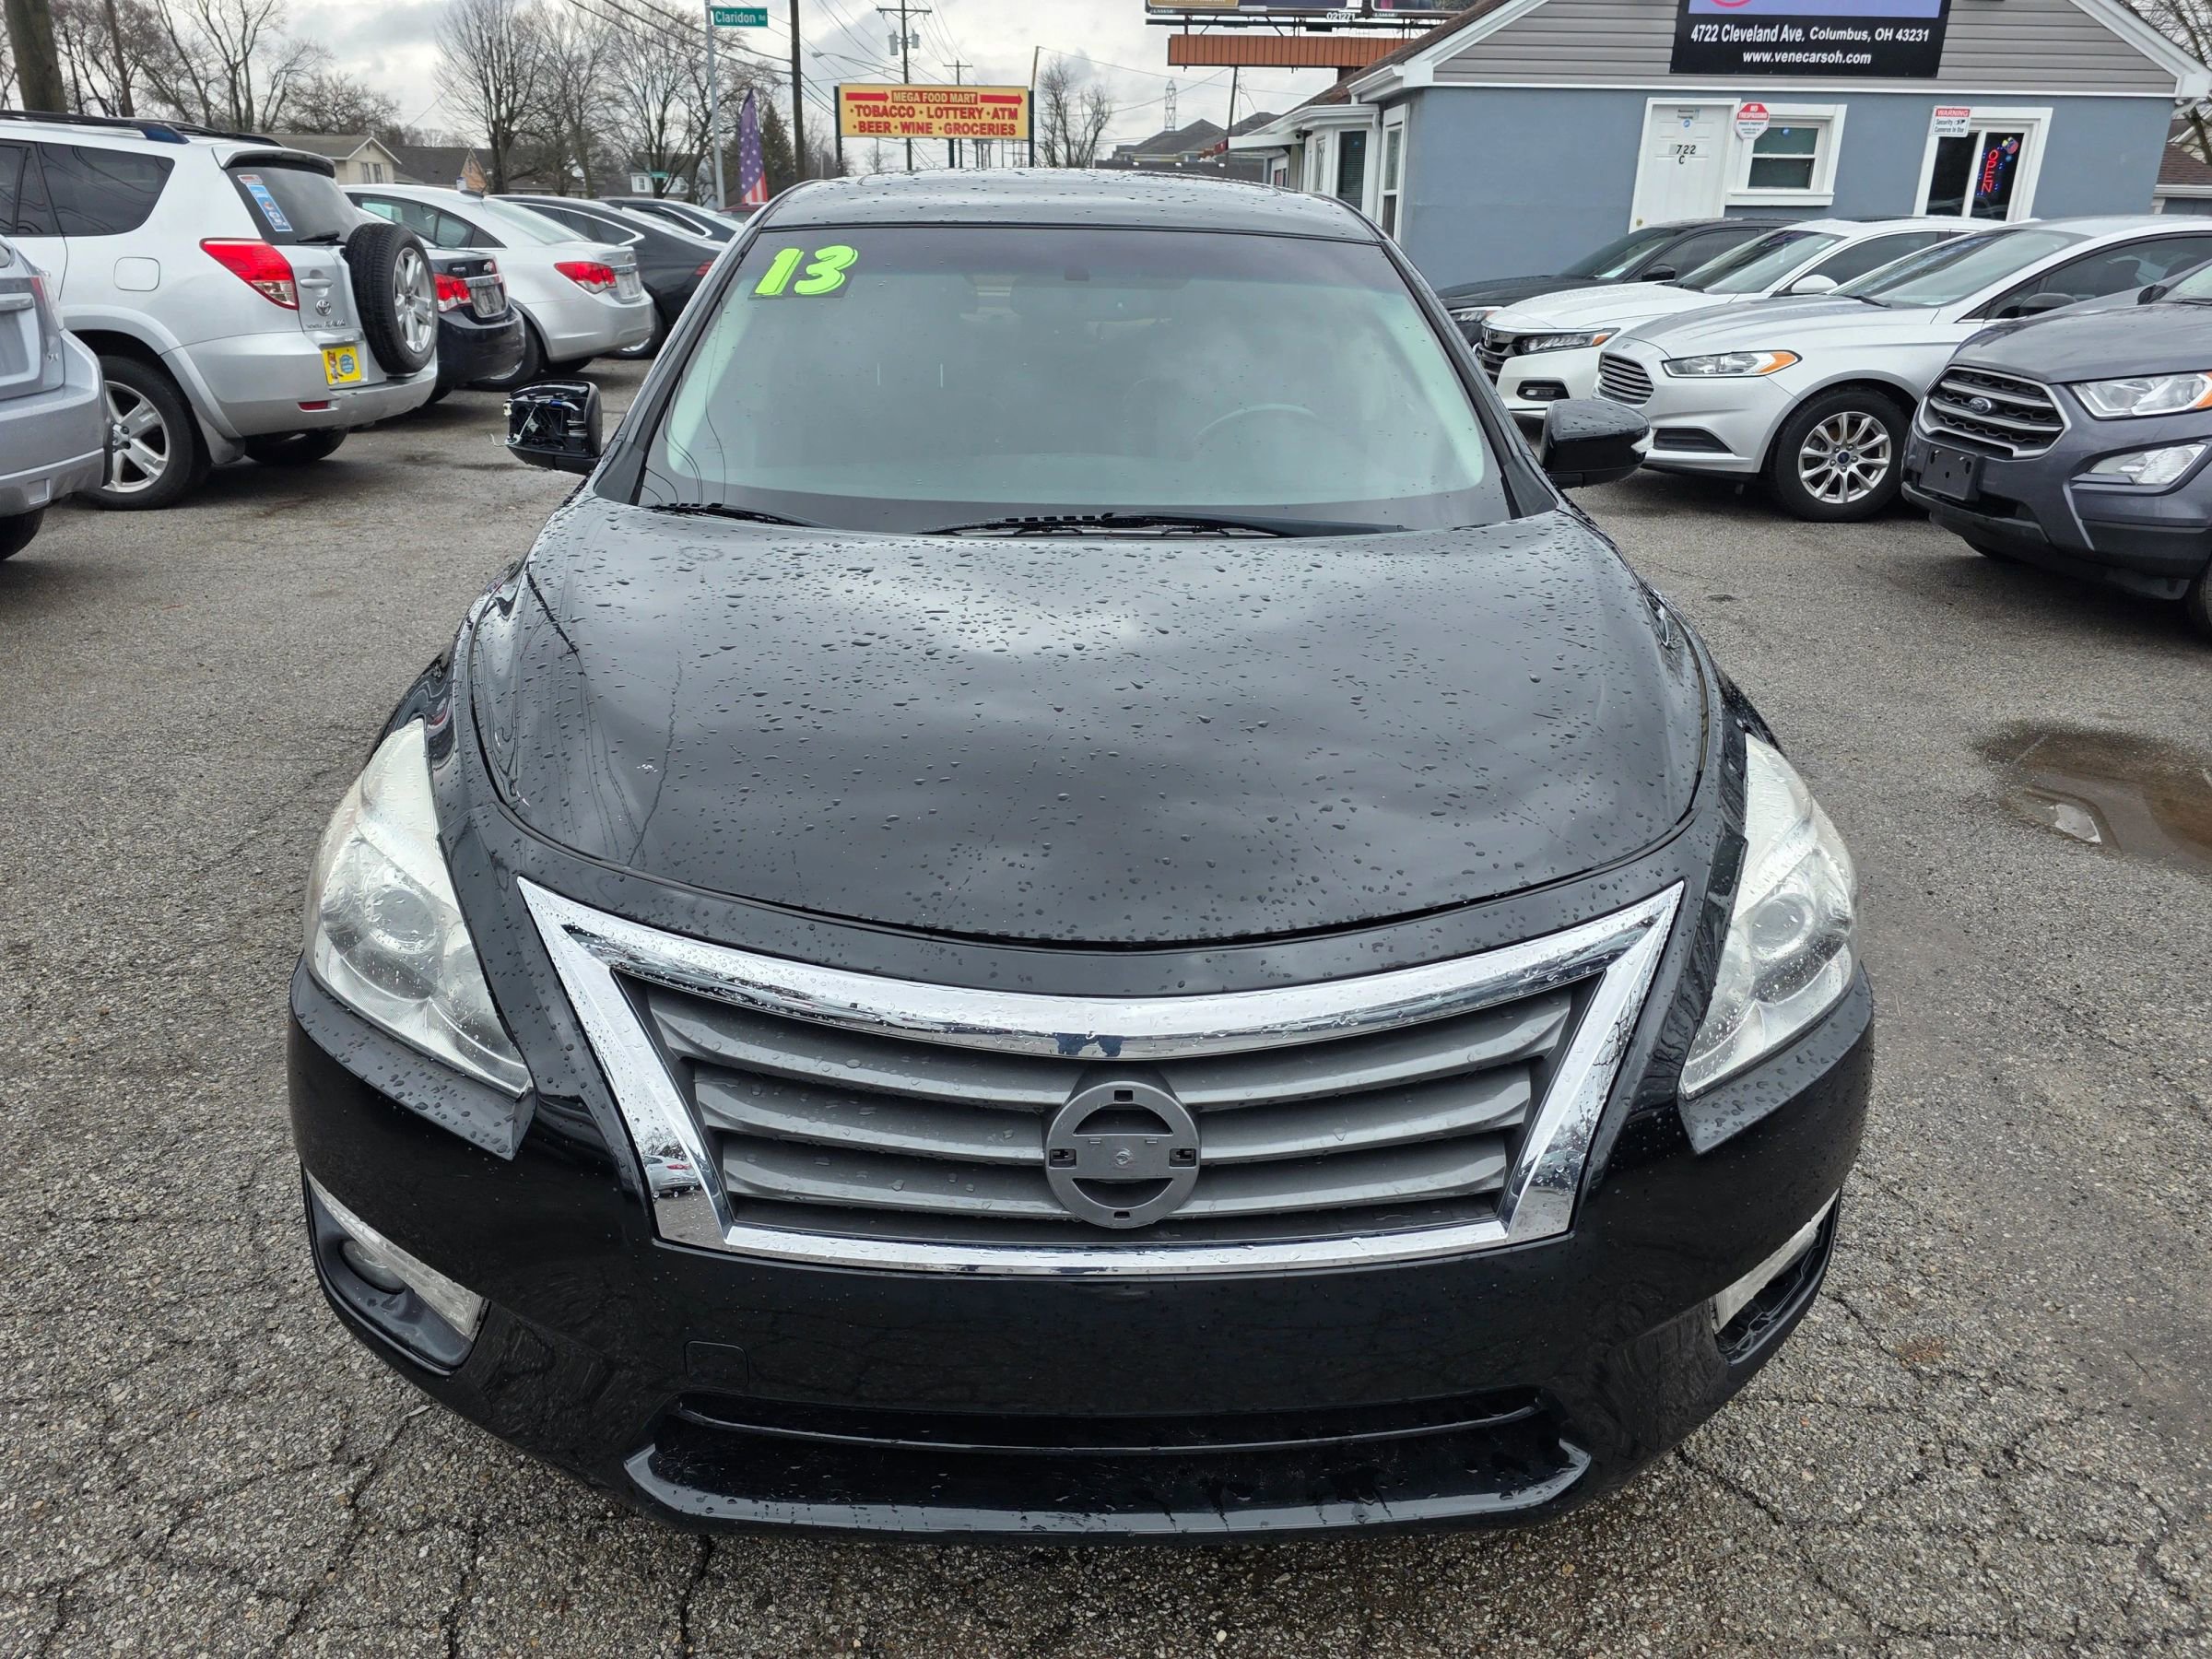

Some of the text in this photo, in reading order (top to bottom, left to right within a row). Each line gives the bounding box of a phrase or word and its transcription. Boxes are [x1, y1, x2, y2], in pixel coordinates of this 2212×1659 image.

[715, 11, 756, 23] Claridon
[1326, 12, 1356, 21] 021271
[1690, 24, 1930, 43] 4722 Cleveland Ave. Columbus, OH 43231
[1742, 50, 1872, 65] www.venecarsoh.com
[893, 91, 976, 105] MEGA FOOD MART
[854, 104, 1018, 121] TOBACCO LOTTERY ATM
[858, 121, 1016, 136] BEER WINE GROCERIES
[1676, 145, 1696, 155] 722
[1982, 149, 1999, 193] OPEN
[755, 245, 858, 295] 13
